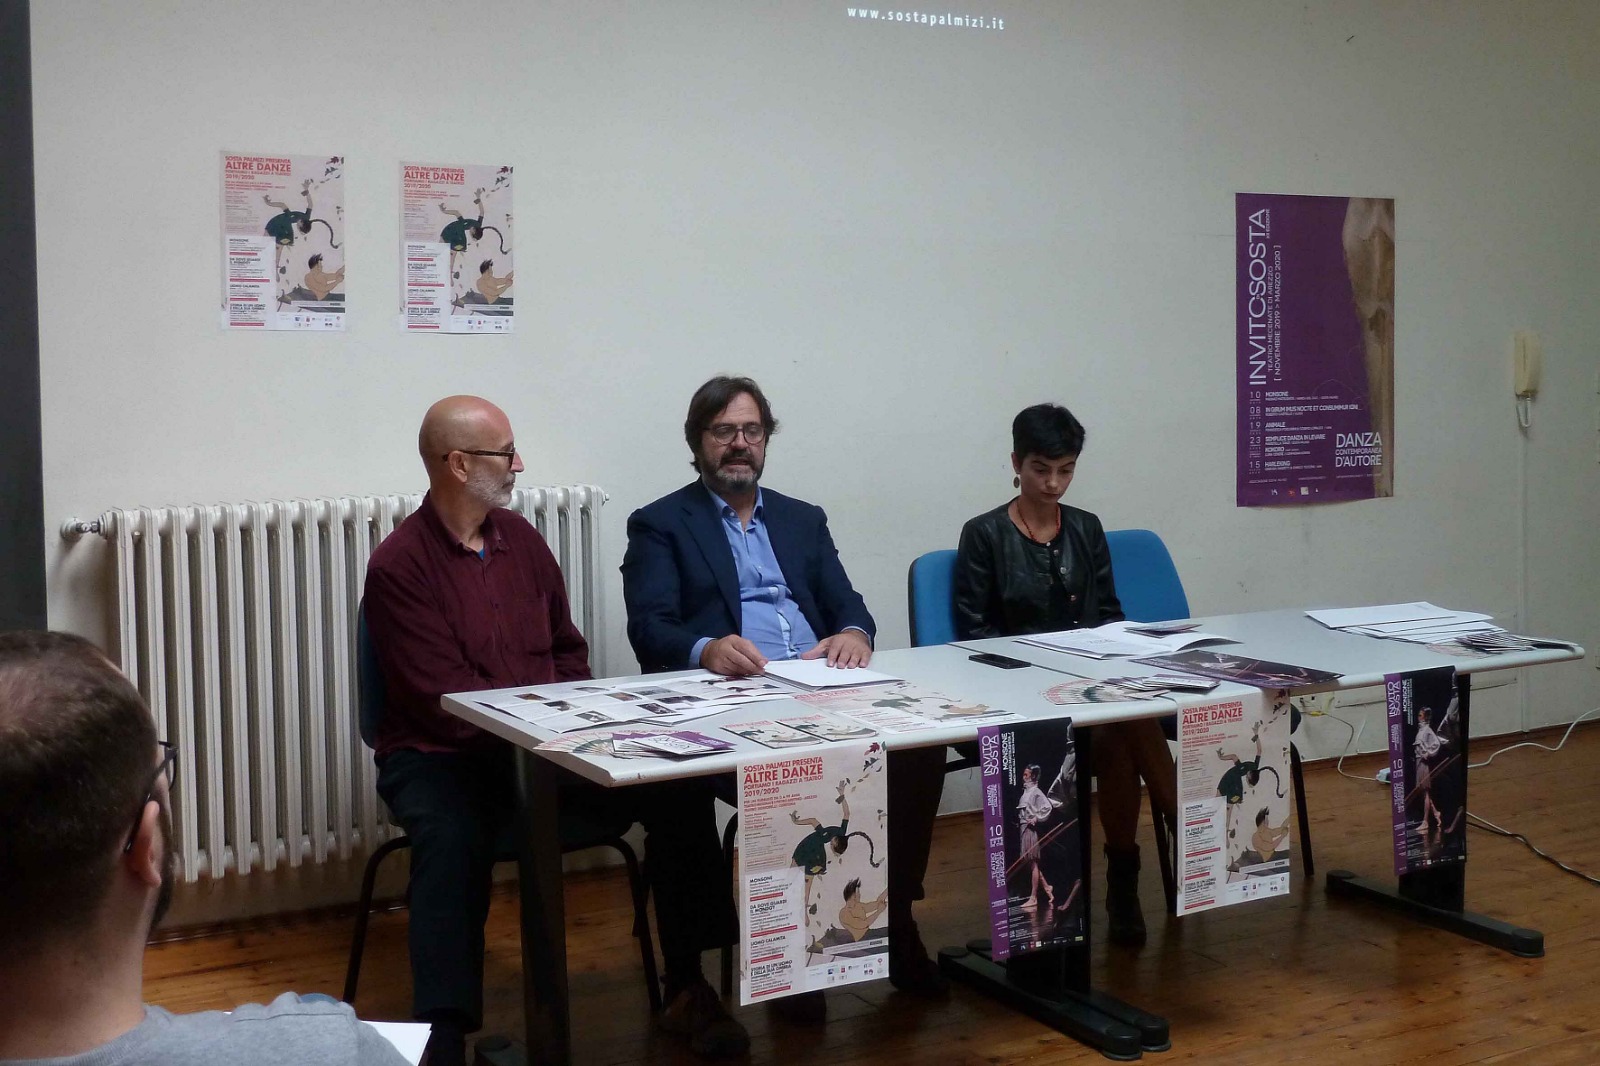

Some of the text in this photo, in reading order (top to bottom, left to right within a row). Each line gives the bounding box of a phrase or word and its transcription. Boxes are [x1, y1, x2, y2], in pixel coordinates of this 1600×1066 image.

[848, 8, 1004, 30] www.sostapalmizi.it
[226, 162, 292, 172] ALTRE DANZE
[404, 171, 464, 181] ALTRE DANZE
[1249, 209, 1266, 296] SOSTA
[1336, 432, 1382, 448] DANZA
[1336, 455, 1382, 467] D'AUTORE
[1183, 708, 1242, 724] ALTRE DANZE
[1183, 727, 1209, 736] 2019/2020
[982, 736, 992, 776] INVITO
[990, 735, 999, 775] SOSTA
[744, 757, 823, 773] SOSTA PALMIZI PRESENTA
[1393, 759, 1402, 769] 10
[744, 764, 823, 784] ALTRE DANZE
[745, 787, 779, 797] 2019/2020
[990, 825, 1002, 837] 10
